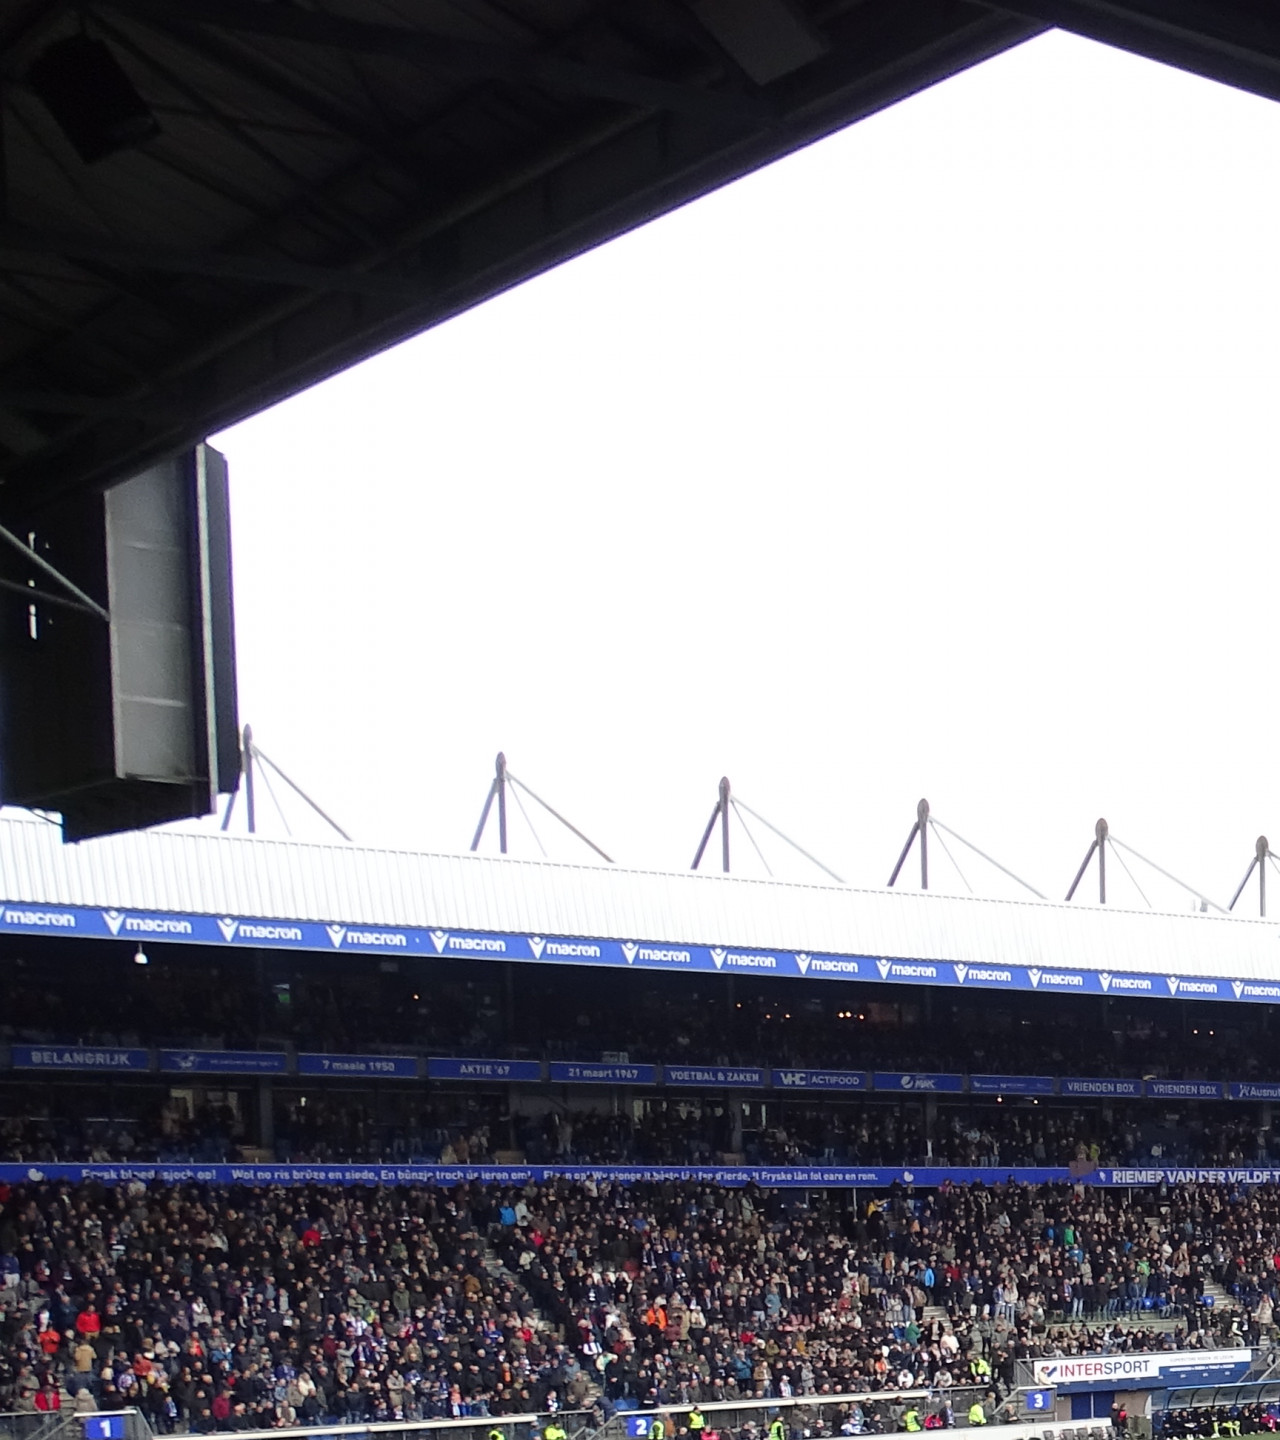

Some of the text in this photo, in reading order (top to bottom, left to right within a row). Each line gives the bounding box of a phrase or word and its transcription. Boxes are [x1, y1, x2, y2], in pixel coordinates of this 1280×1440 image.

[6, 909, 75, 927] macron
[126, 917, 192, 934] macron
[240, 924, 303, 941] macron
[347, 931, 407, 947] macron
[450, 936, 507, 952] macron
[547, 942, 601, 958] macron
[639, 947, 691, 963] macron
[727, 953, 777, 968] macron
[811, 959, 859, 973] macron
[891, 964, 937, 978] macron
[968, 966, 1011, 982] macron
[1042, 973, 1084, 986] macron
[1111, 974, 1151, 990] macron
[1179, 979, 1218, 994] macron
[1243, 982, 1280, 997] macron
[31, 1052, 130, 1066] BELANGRIJK
[459, 1064, 491, 1074] AKTIE
[568, 1068, 638, 1079] 21 maart 1967
[670, 1071, 759, 1082] VOETBAL & ZAKEN
[780, 1073, 859, 1086] VHC ACTIFOOD
[1067, 1082, 1135, 1093] VRIENDEN BOX
[1153, 1084, 1217, 1095] VRIENDEN BOX
[231, 1169, 254, 1180] Wol
[256, 1172, 272, 1180] no
[274, 1170, 290, 1180] ris
[328, 1172, 342, 1180] en
[380, 1171, 395, 1180] En
[436, 1170, 463, 1180] troch
[761, 1171, 792, 1183] Fryske
[794, 1171, 809, 1181] lân
[810, 1171, 822, 1181] fol
[845, 1173, 856, 1181] en
[1167, 1171, 1196, 1183] VAN
[1060, 1359, 1151, 1378] INTERSPORT
[1034, 1394, 1044, 1408] 3
[99, 1420, 112, 1437] 1
[636, 1419, 647, 1436] 2
